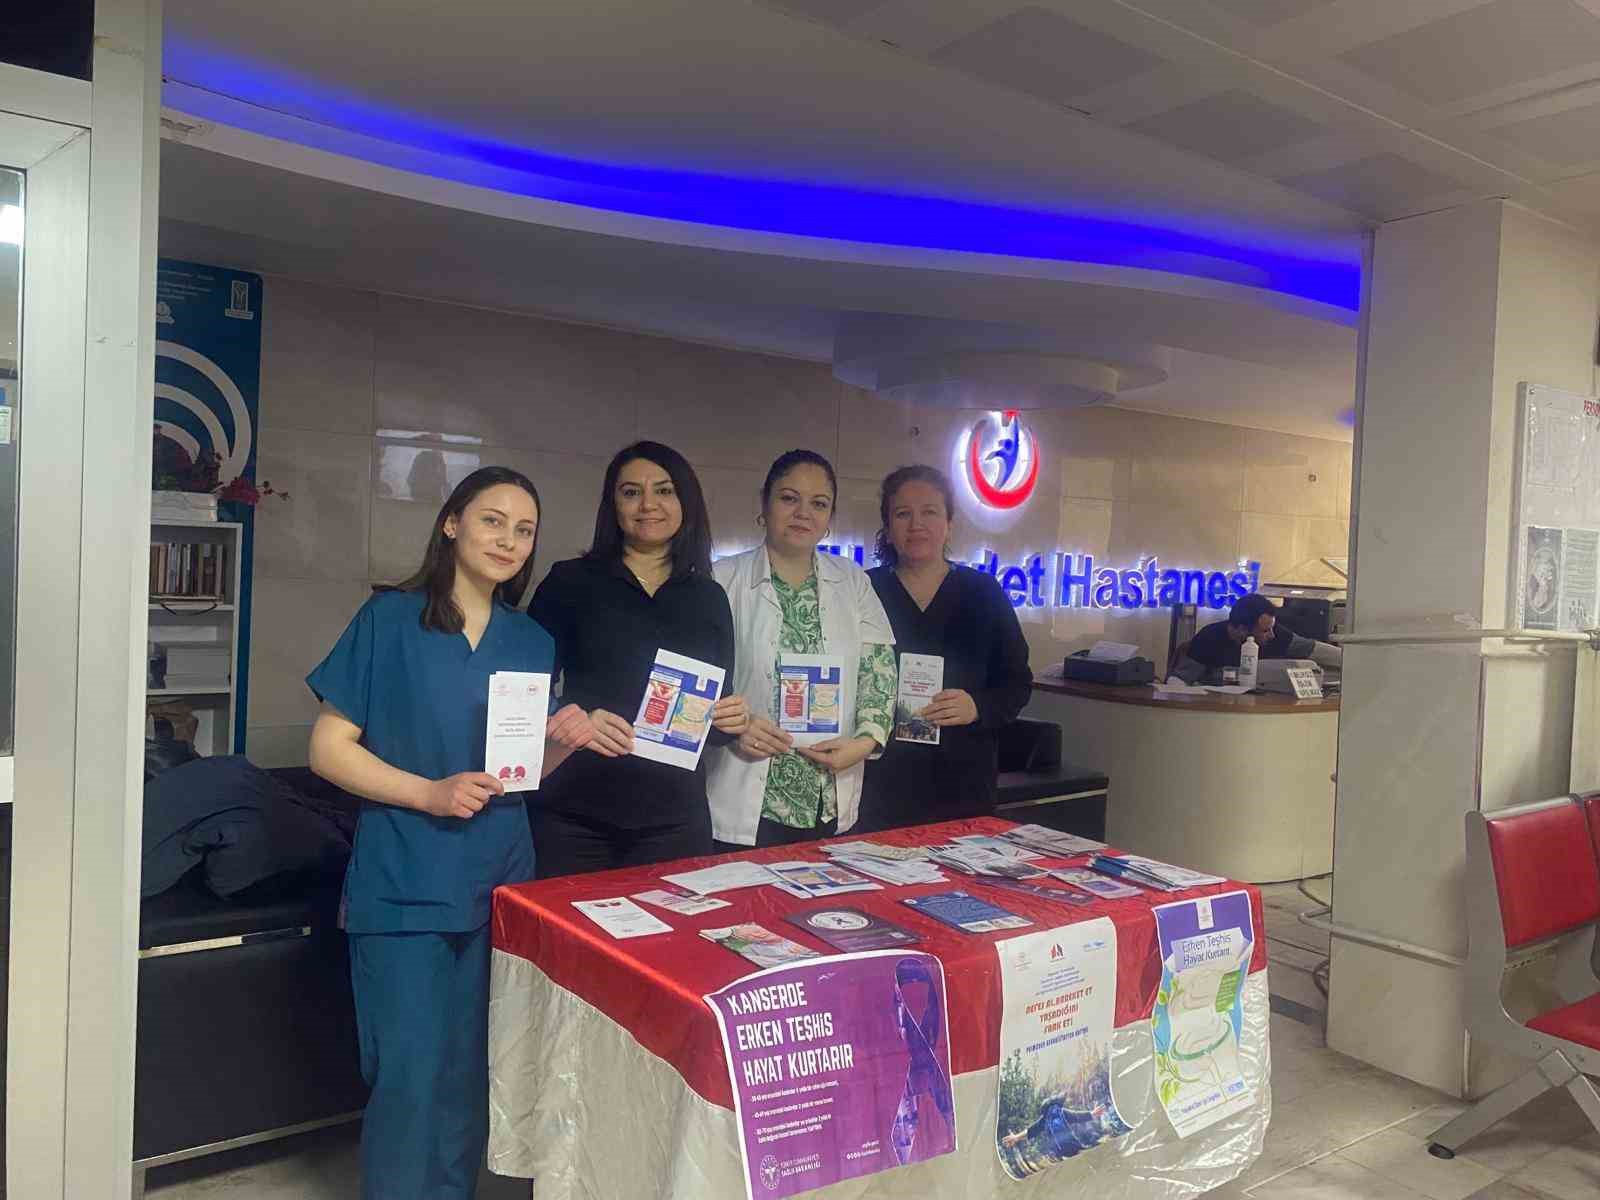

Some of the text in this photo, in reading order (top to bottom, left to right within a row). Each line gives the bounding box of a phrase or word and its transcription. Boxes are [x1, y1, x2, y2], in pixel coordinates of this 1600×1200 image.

[1059, 552, 1262, 609] Hastanesi
[726, 982, 808, 1016] KANSERDE
[736, 1012, 834, 1051] ERKEN TEŞHİS
[742, 1043, 854, 1087] HAYAT KURTARIR
